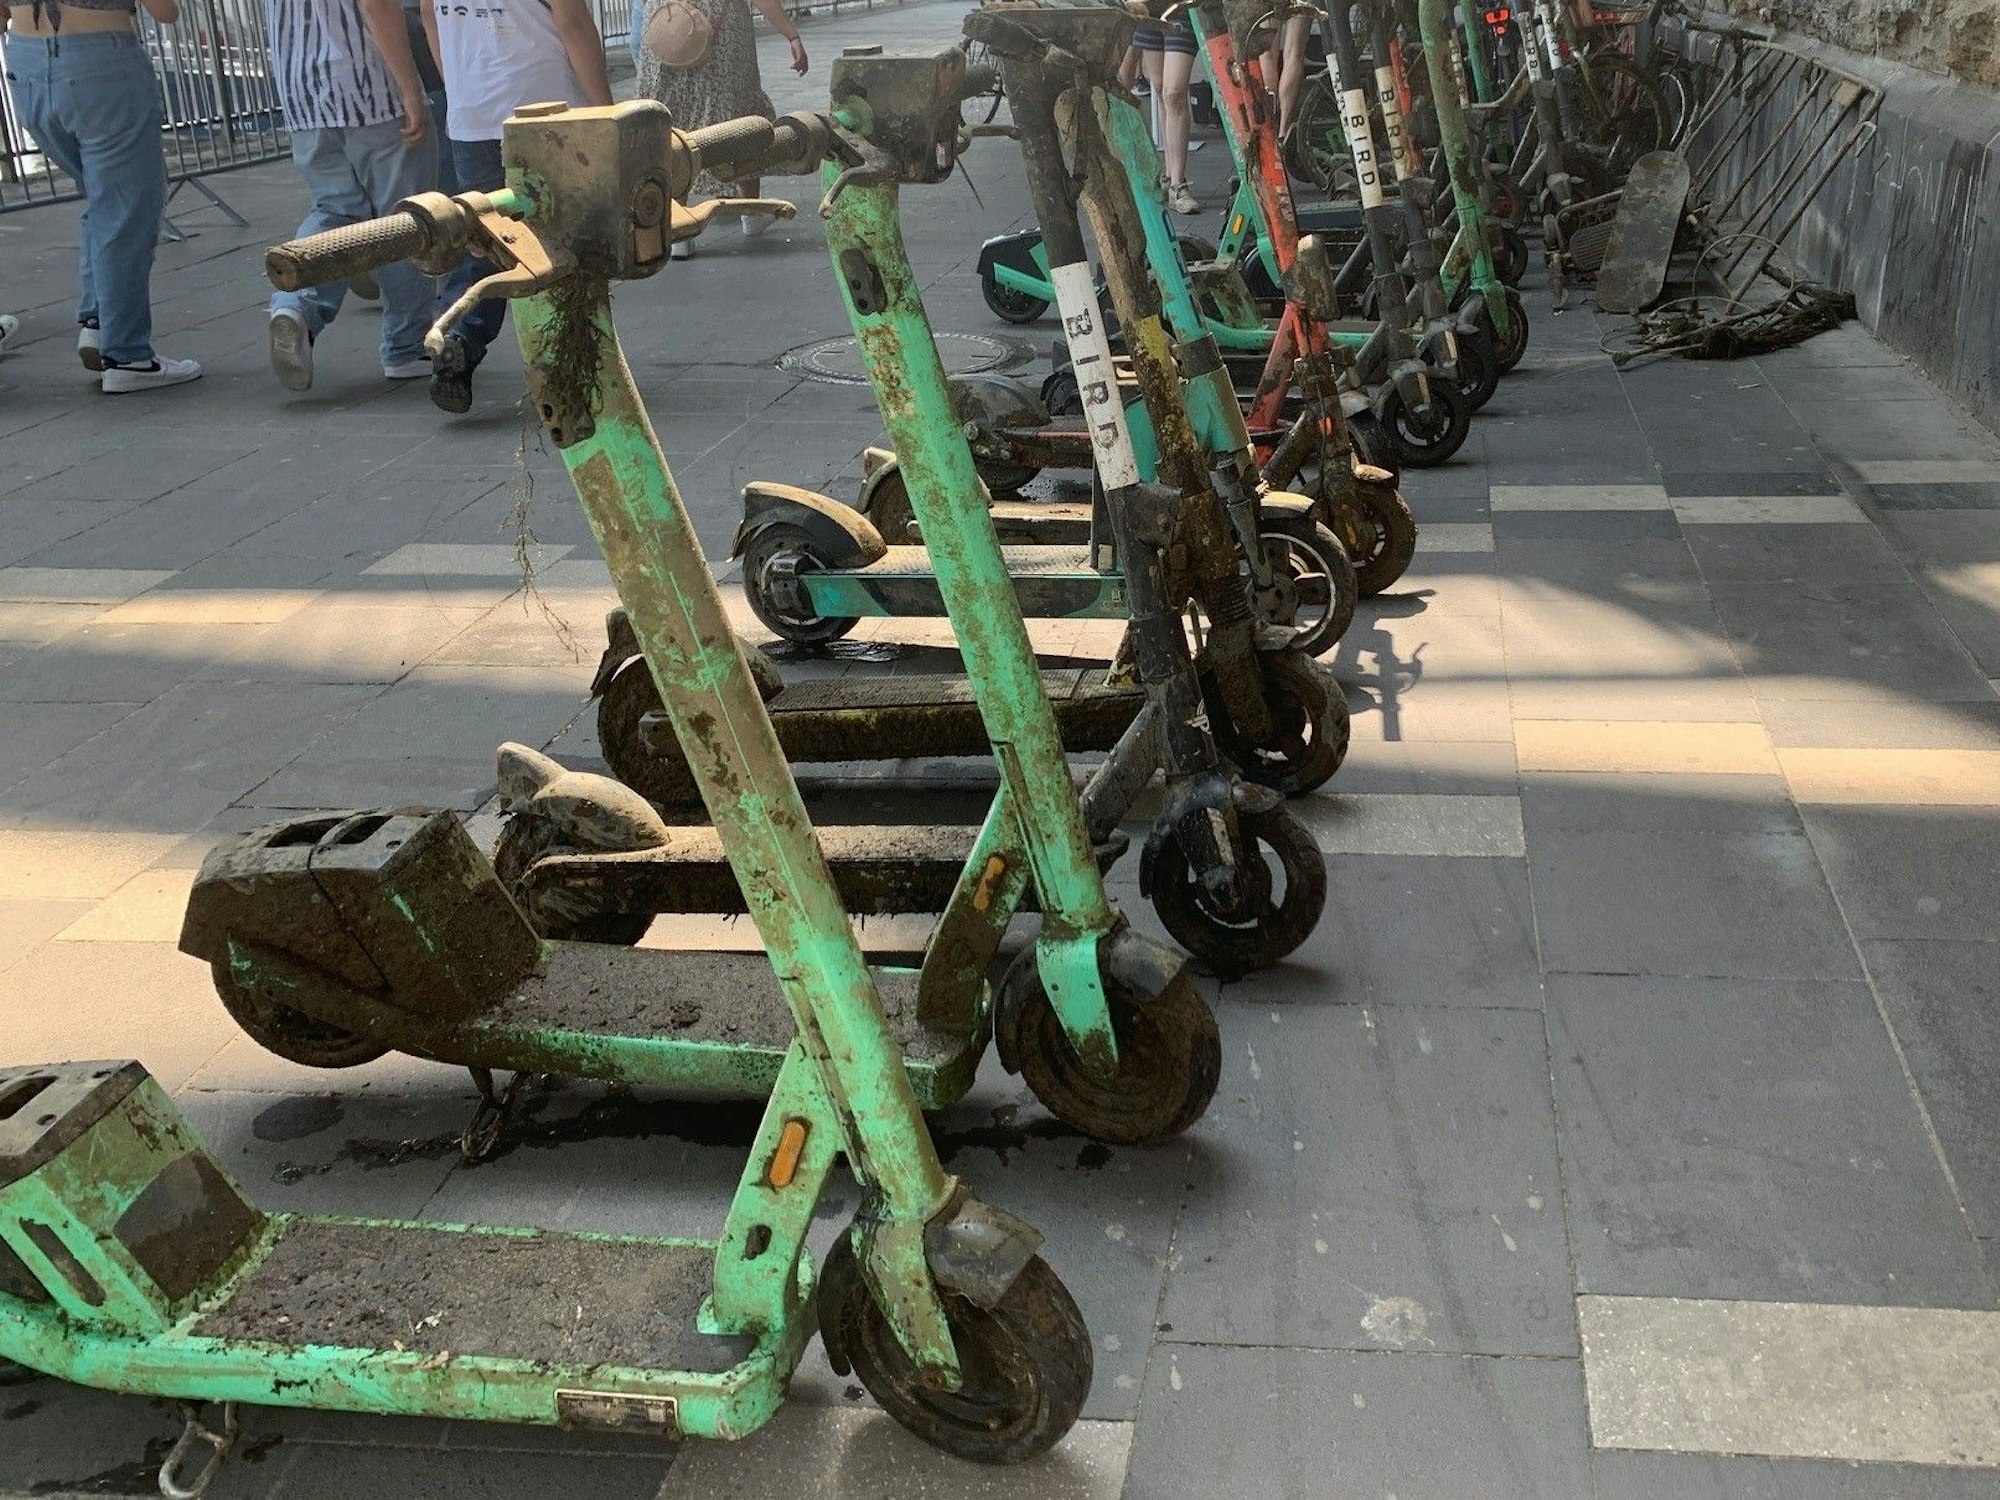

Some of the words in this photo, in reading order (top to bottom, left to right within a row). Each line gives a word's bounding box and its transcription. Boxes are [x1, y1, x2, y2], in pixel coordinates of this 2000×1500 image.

[1351, 115, 1375, 185] BIRD
[1381, 88, 1405, 160] BIRD
[1066, 309, 1119, 450] BIRD
